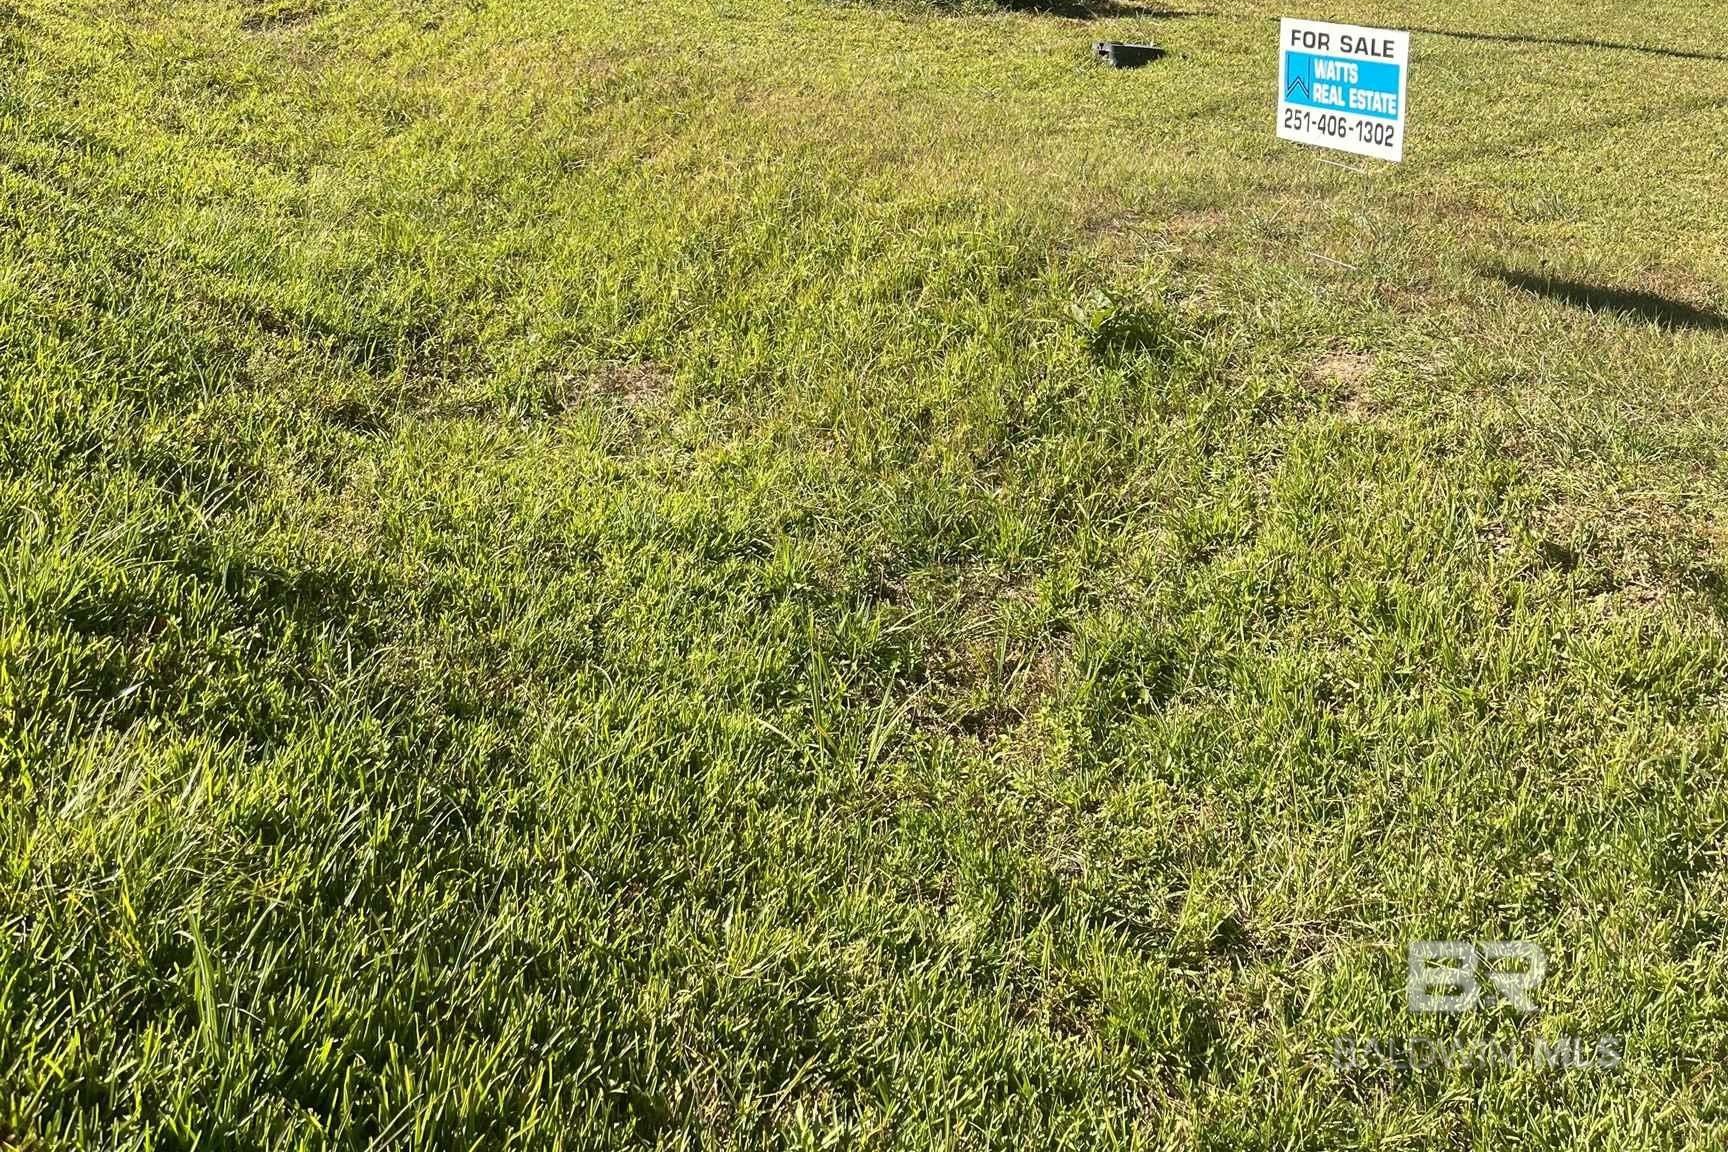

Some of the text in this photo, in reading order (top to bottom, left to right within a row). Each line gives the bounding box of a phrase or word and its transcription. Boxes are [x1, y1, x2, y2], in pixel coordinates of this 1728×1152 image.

[1291, 29, 1395, 58] FOR SALE
[1313, 58, 1359, 84] WATTS
[1312, 82, 1398, 115] REAL ESTATE
[1284, 108, 1394, 147] 251-406-1302
